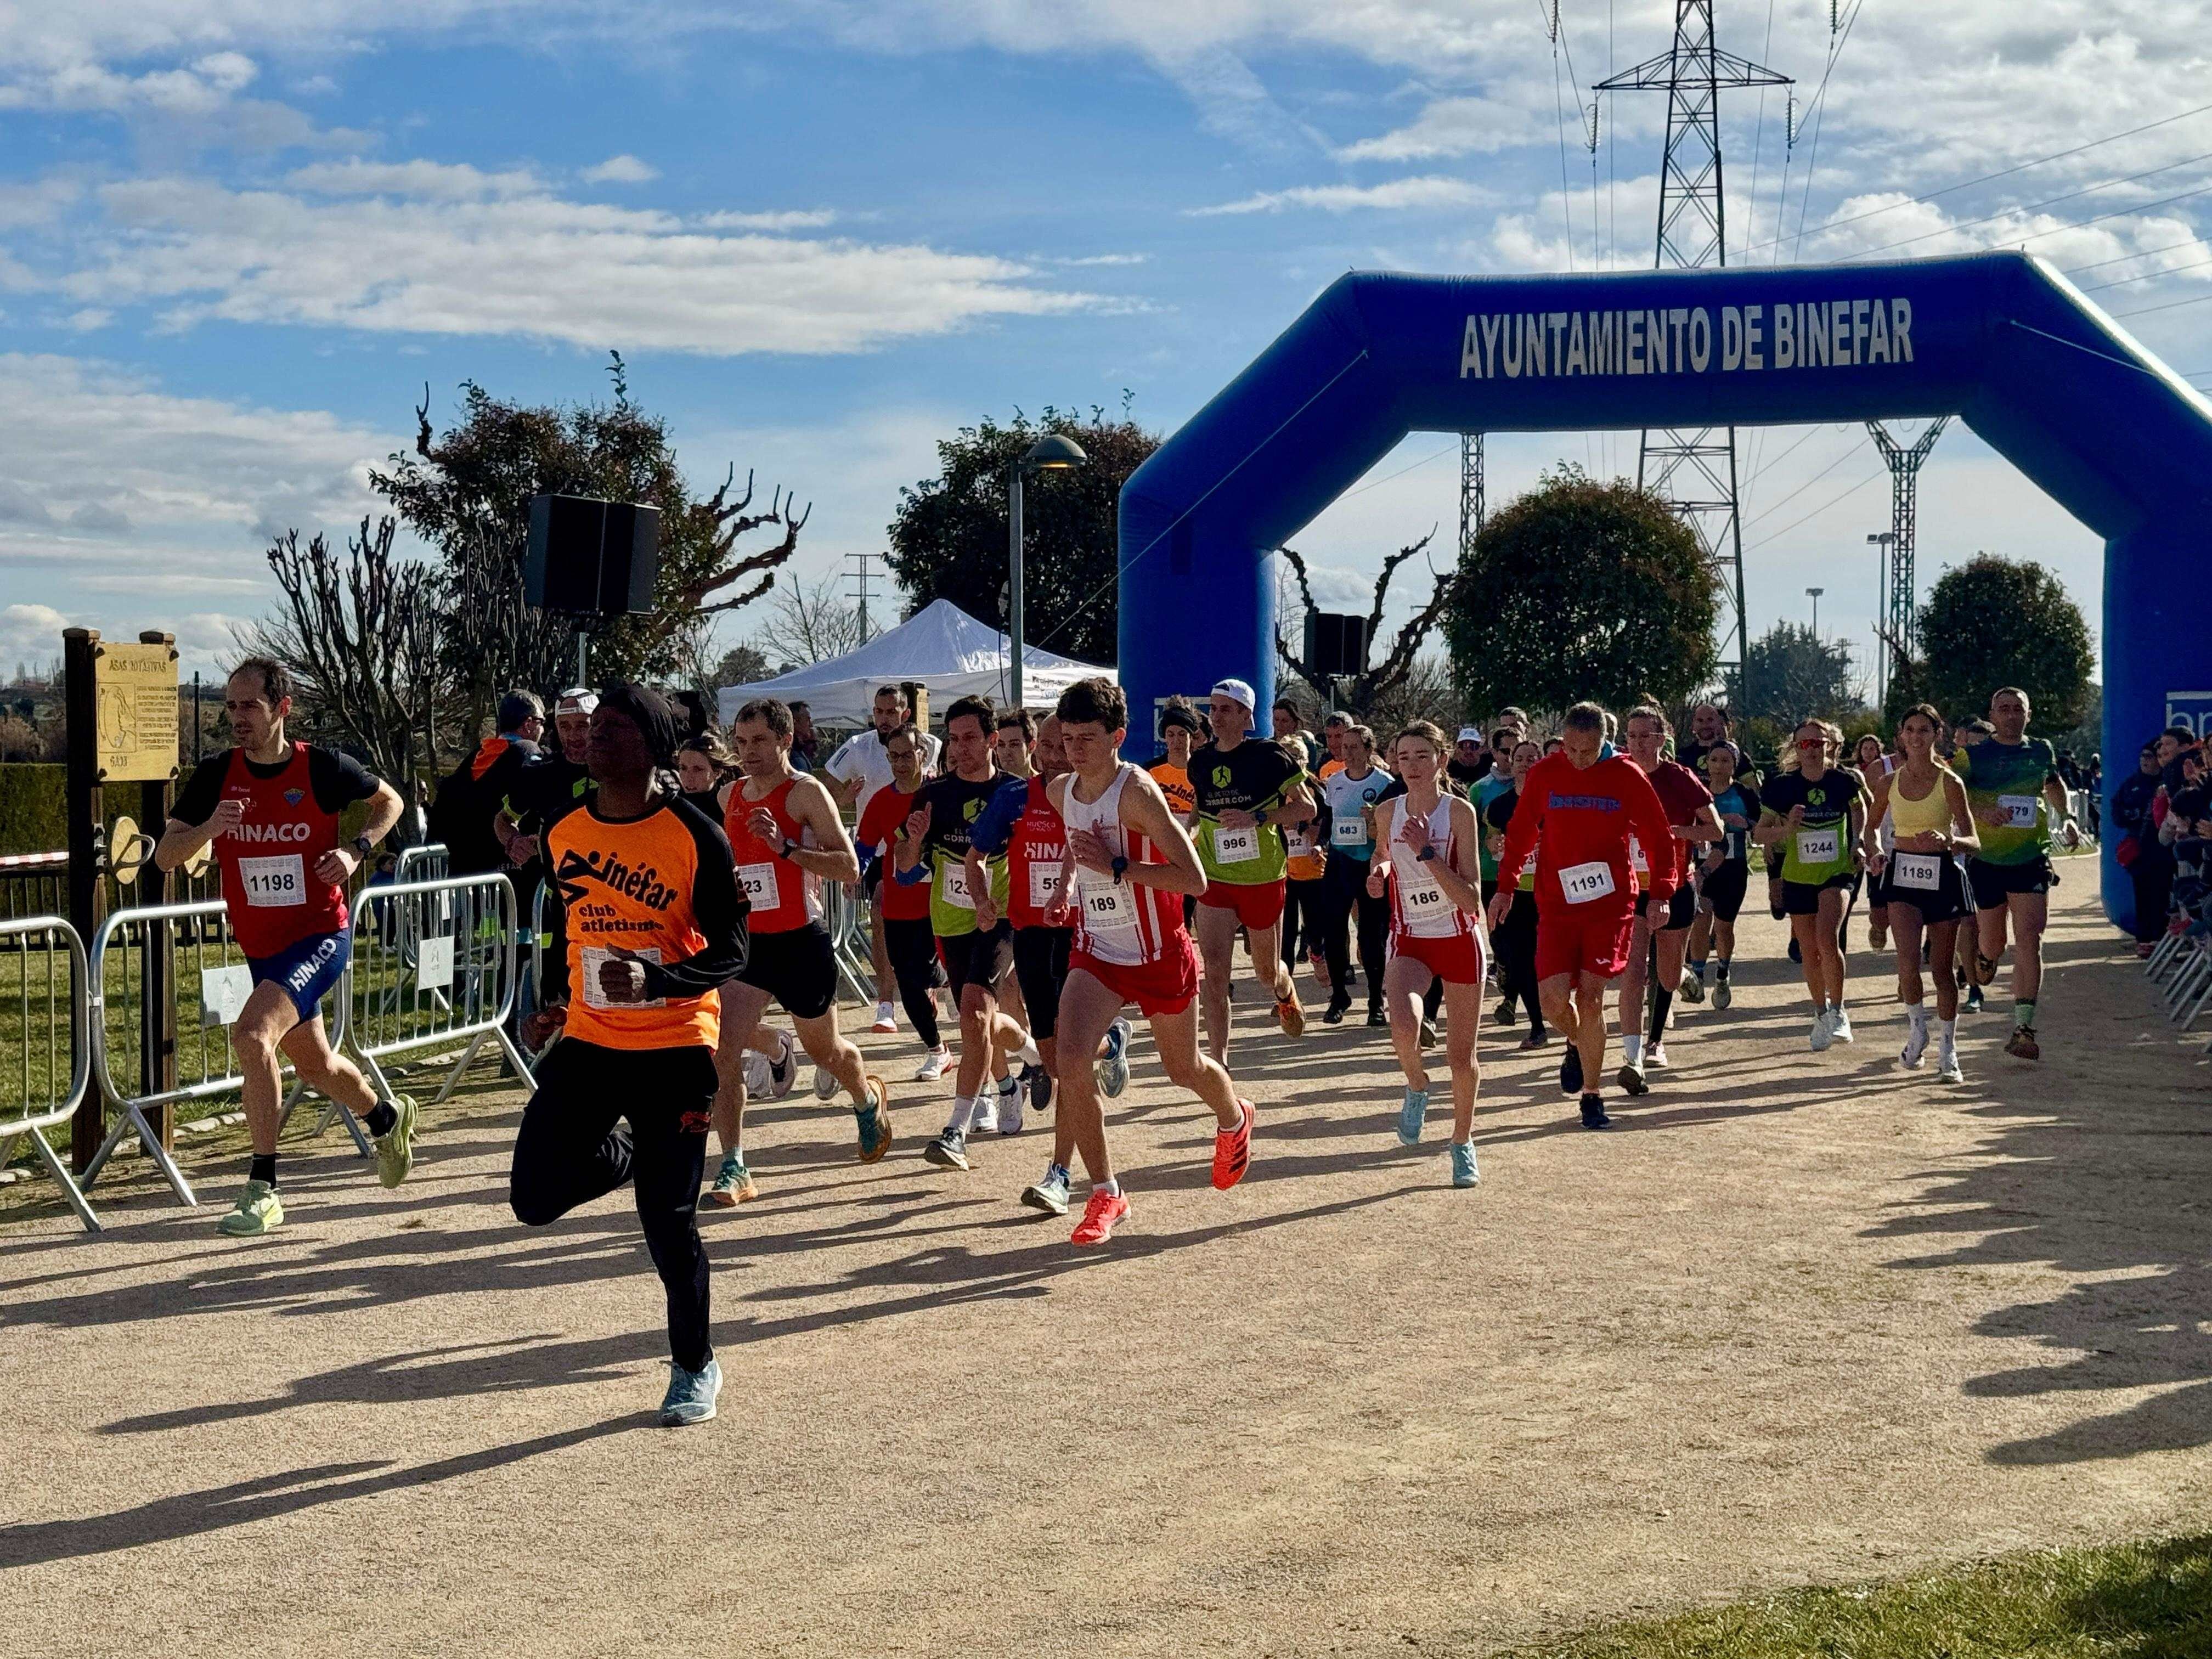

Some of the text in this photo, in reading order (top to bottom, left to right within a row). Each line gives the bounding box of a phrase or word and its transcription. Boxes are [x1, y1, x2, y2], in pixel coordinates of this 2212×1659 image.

[1459, 297, 1914, 379] AYUNTAMIENTO DE BINEFAR
[1339, 826, 1358, 834] 683
[1223, 837, 1247, 850] 996
[1804, 842, 1833, 854] 1244
[1901, 865, 1933, 879] 1189
[250, 873, 295, 892] 1198
[1570, 872, 1605, 893] 1191
[1089, 896, 1116, 912] 189
[1409, 890, 1440, 906] 186
[578, 903, 617, 917] club
[580, 918, 665, 933] atletismo
